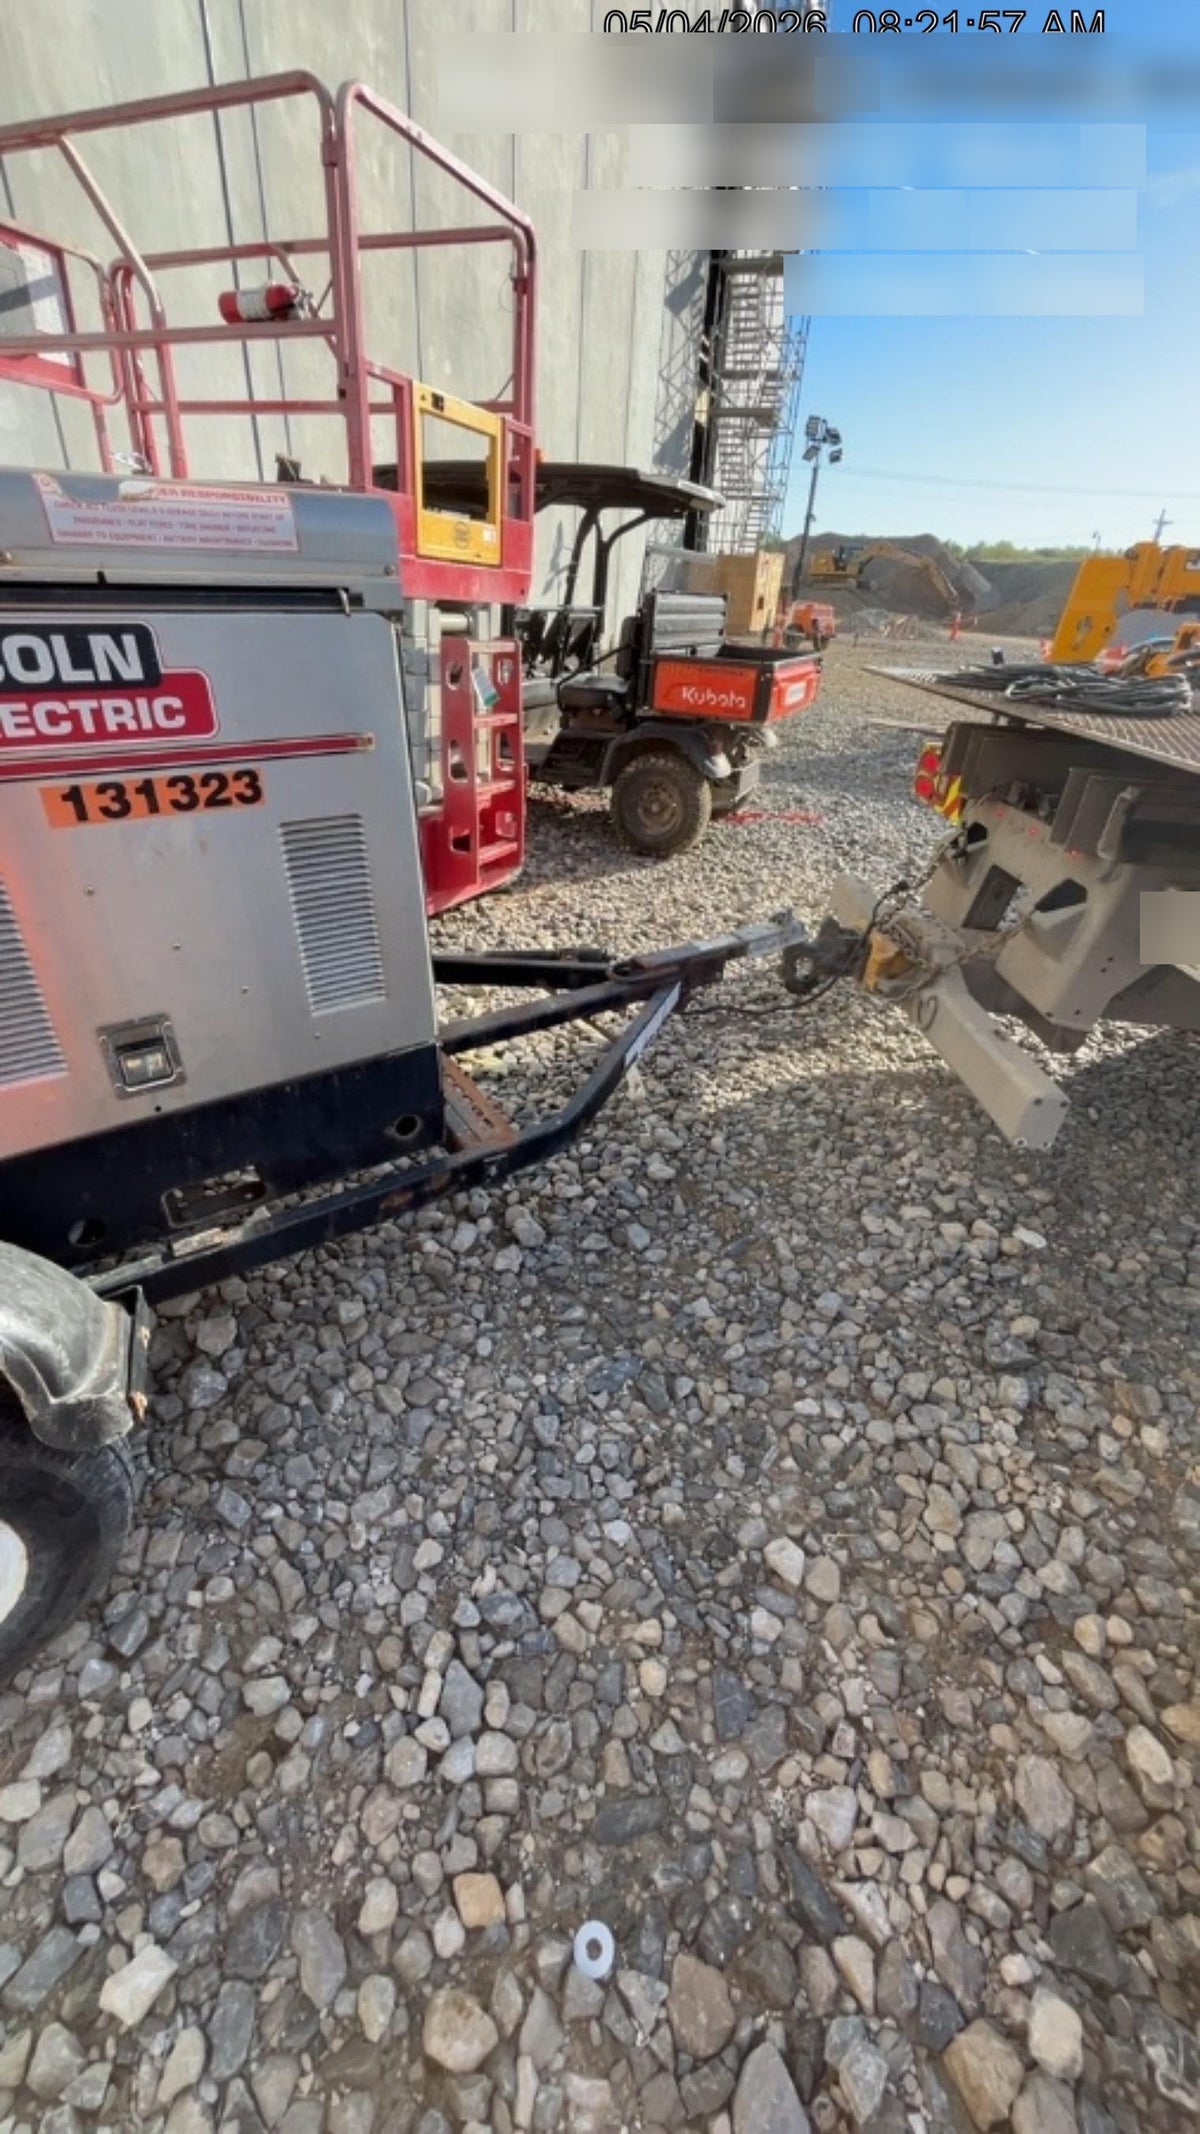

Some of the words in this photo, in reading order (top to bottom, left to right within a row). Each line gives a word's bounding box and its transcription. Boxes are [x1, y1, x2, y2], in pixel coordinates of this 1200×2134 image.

[0, 633, 145, 683] OLN
[0, 696, 186, 738] ECTRIC
[682, 686, 746, 708] Kubota
[61, 769, 263, 822] 131323
